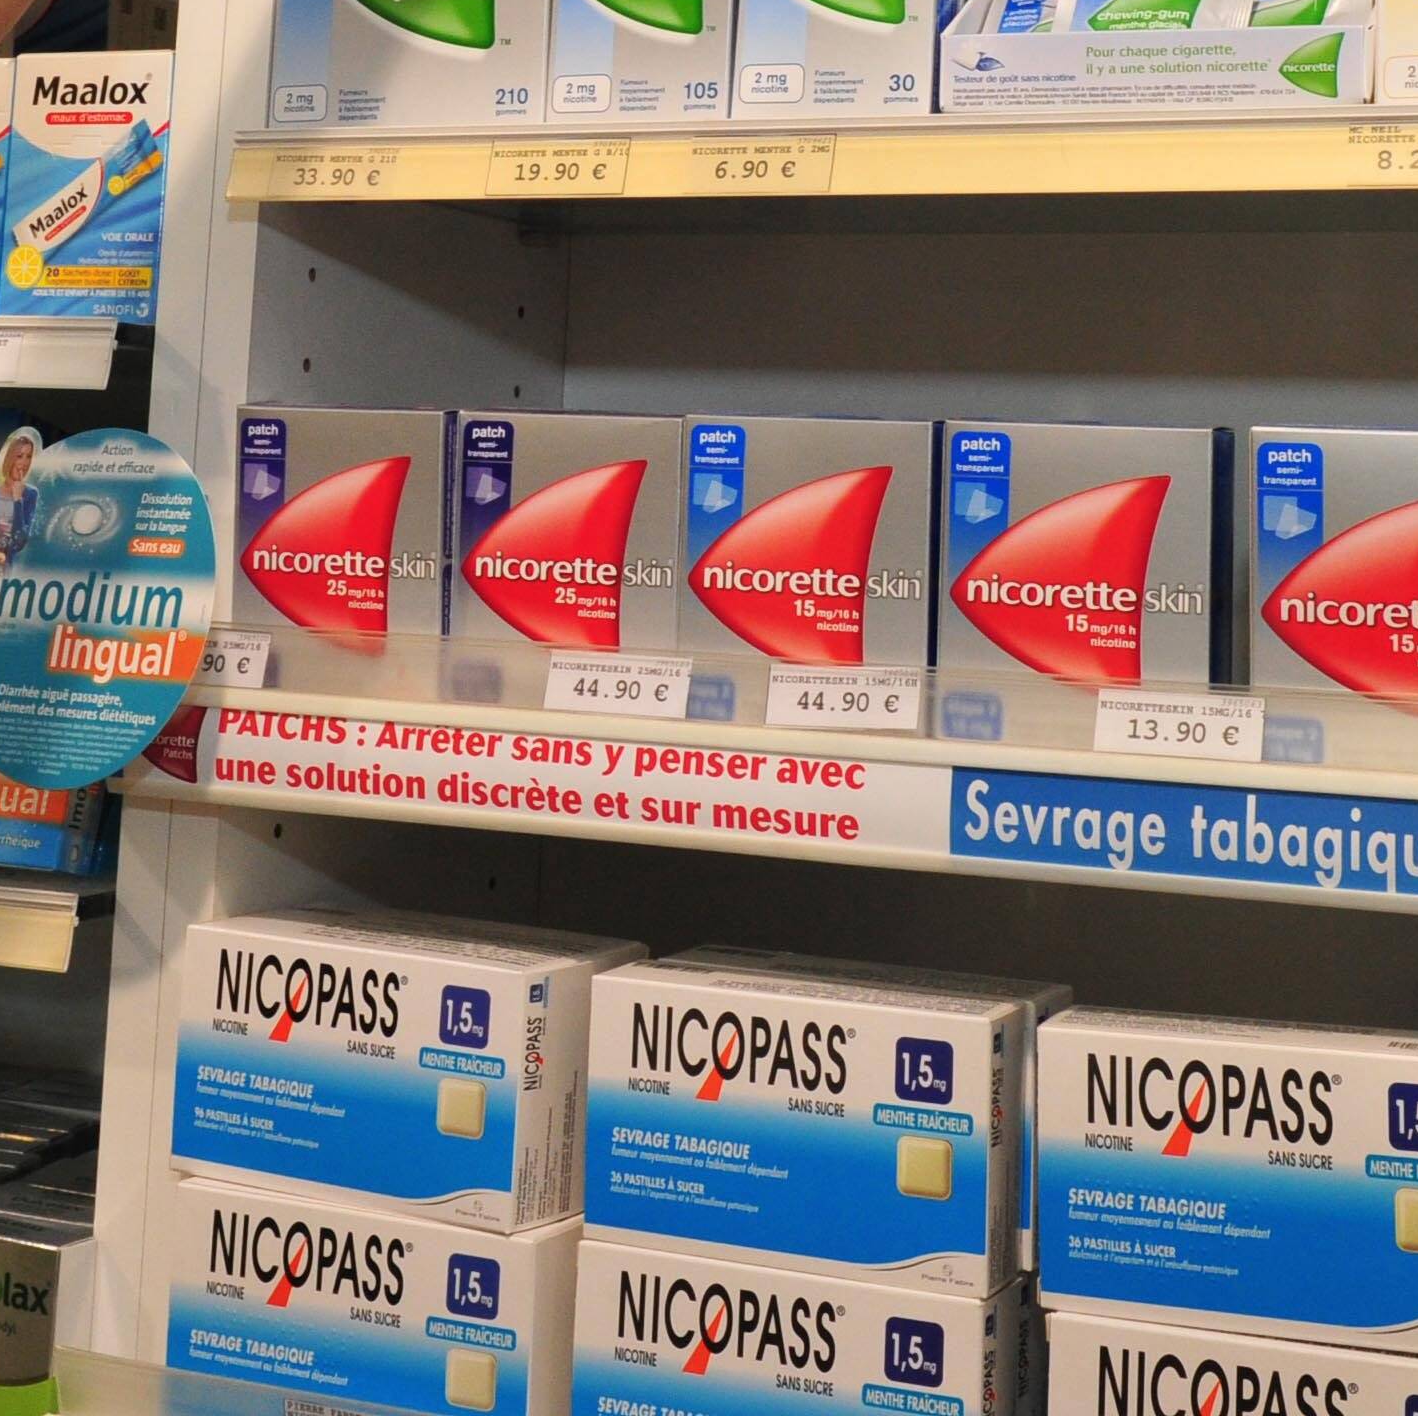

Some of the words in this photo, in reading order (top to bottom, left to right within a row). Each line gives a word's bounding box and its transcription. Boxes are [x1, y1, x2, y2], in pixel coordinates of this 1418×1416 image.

[1085, 44, 1118, 59] Pour
[1122, 44, 1167, 61] chaque
[1172, 42, 1237, 61] cigarette,
[1085, 61, 1094, 75] il
[1118, 64, 1139, 73] une
[1148, 60, 1202, 73] solution
[1207, 59, 1267, 73] nicorette
[32, 76, 149, 106] Maalox
[494, 87, 528, 106] 210
[1348, 134, 1417, 144] NICORETTE
[293, 168, 358, 186] 33.90
[365, 168, 380, 188] €
[714, 161, 772, 180] 6.90
[780, 160, 796, 179] €
[93, 304, 133, 316] SANOFI
[472, 426, 505, 442] patch
[101, 443, 134, 458] Action
[73, 460, 104, 476] rapide
[107, 462, 117, 473] et
[120, 460, 155, 475] efficace
[132, 540, 158, 554] Sans
[161, 543, 181, 554] eau
[253, 546, 384, 577] nicorette
[390, 553, 435, 579] skin
[703, 564, 859, 596] nicorette
[867, 572, 920, 600] skin
[49, 626, 174, 681] lingual
[573, 680, 640, 701] 44.90
[653, 683, 669, 702] €
[219, 709, 347, 745] PATCHS
[376, 718, 502, 756] Arrêter
[510, 733, 592, 767] sans
[604, 743, 625, 778] y
[634, 743, 765, 785] penser
[775, 758, 866, 791] avec
[215, 754, 276, 783] une
[285, 759, 425, 800] solution
[437, 770, 582, 815] discrète
[593, 789, 629, 820] et
[640, 794, 702, 828] sur
[712, 802, 859, 842] mesure
[965, 781, 1166, 870] Sevrage
[216, 948, 400, 1039] NICOPASS
[1087, 1053, 1333, 1145] NICOPASS
[1268, 1151, 1297, 1167] SANS
[1299, 1152, 1333, 1172] SUCRE
[1369, 1160, 1416, 1180] MENTHE
